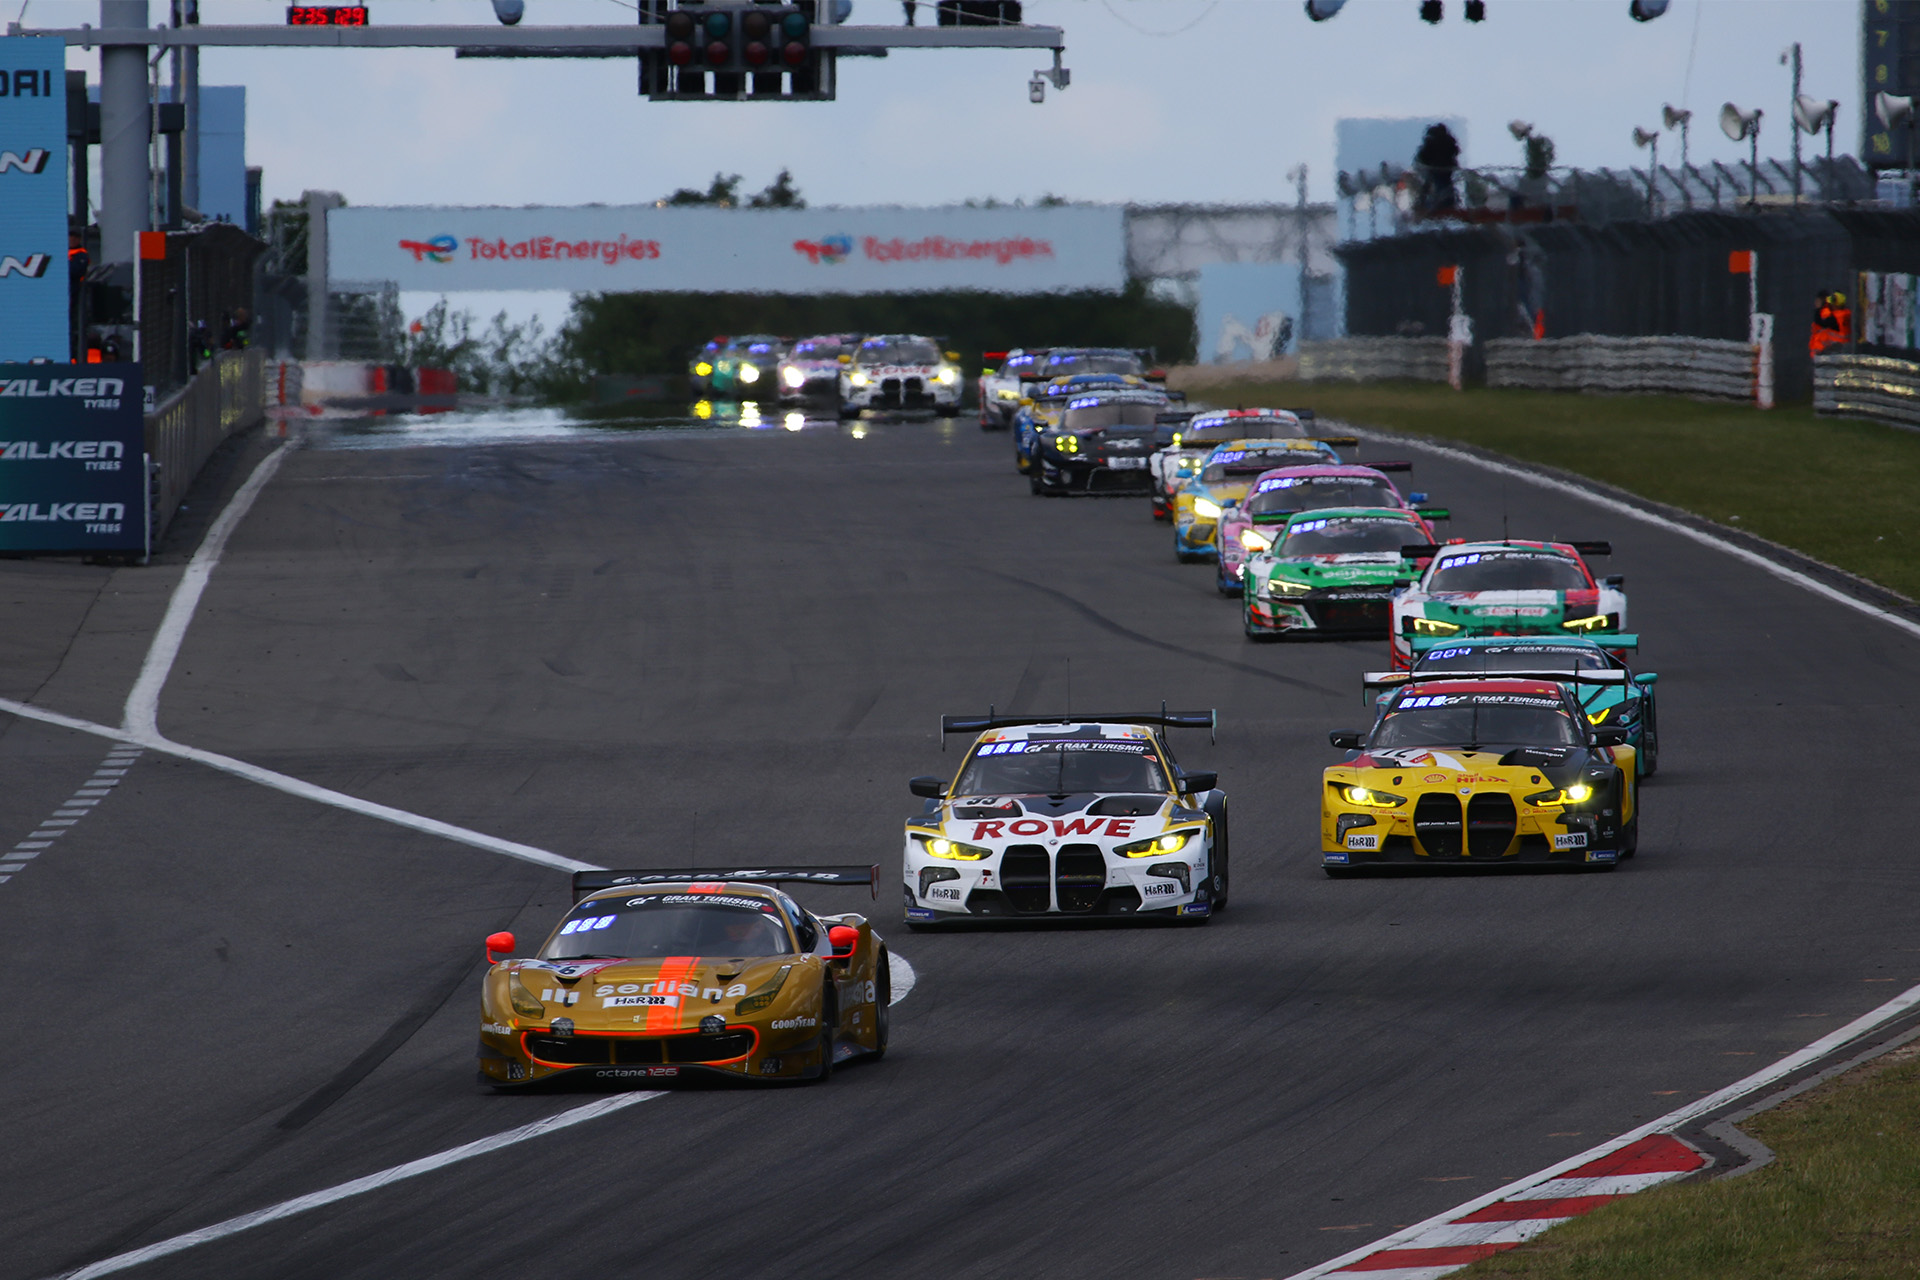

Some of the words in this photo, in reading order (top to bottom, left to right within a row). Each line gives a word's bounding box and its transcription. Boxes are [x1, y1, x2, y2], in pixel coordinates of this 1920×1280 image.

[1875, 30, 1889, 47] 7
[1875, 64, 1888, 84] 8
[465, 233, 660, 265] TotalEnergies
[84, 399, 120, 409] TYRES
[85, 461, 121, 471] TYRES
[86, 523, 121, 534] TYRES
[1428, 647, 1472, 660] 004
[1545, 646, 1593, 654] TURISMO
[1507, 695, 1560, 706] TURISMO
[1055, 742, 1090, 750] GRAN
[1090, 743, 1145, 752] TURISMO
[1457, 775, 1509, 783] HELIX
[972, 818, 1136, 841] ROWE
[702, 895, 762, 908] TURISMO
[595, 978, 748, 1001] serliana
[771, 1016, 816, 1029] GOODYEAR
